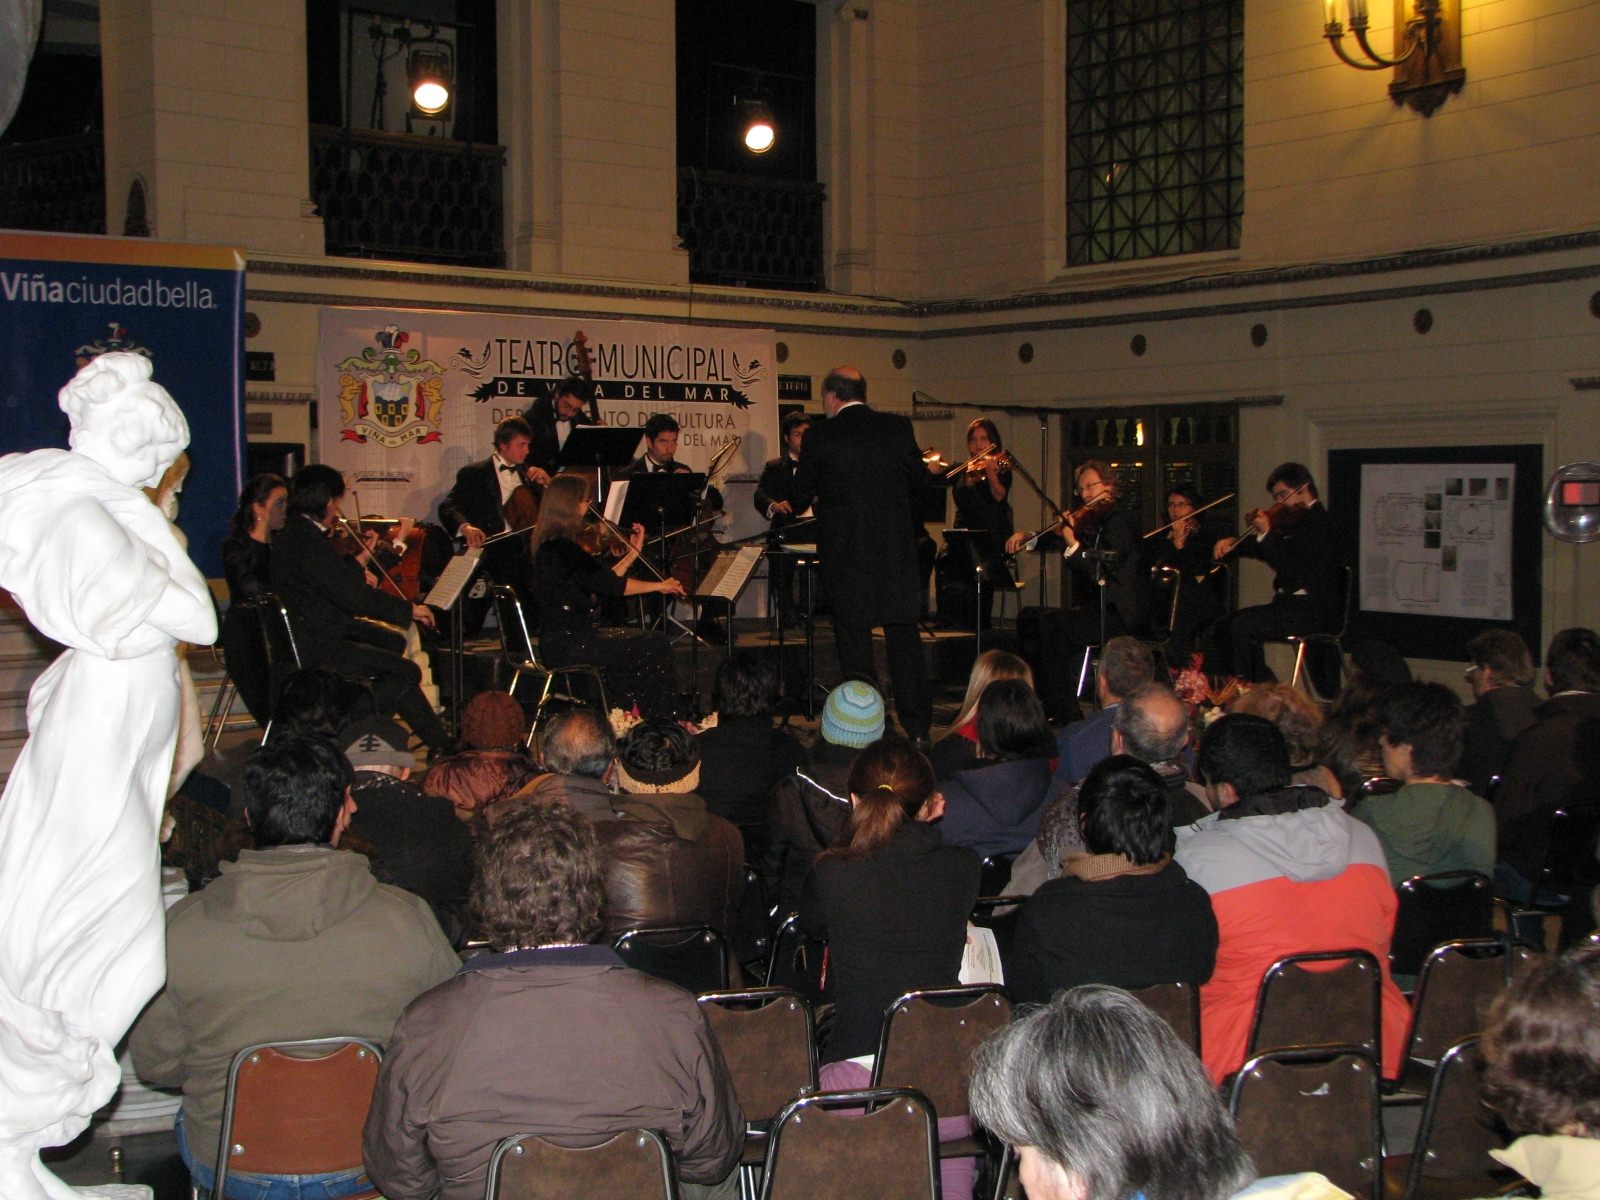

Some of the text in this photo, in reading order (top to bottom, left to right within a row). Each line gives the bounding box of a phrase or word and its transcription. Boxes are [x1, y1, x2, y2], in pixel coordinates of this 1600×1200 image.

[598, 343, 733, 382] MUNICIPAL
[498, 381, 729, 401] DE VA DEL MAR
[683, 433, 706, 447] DEL
